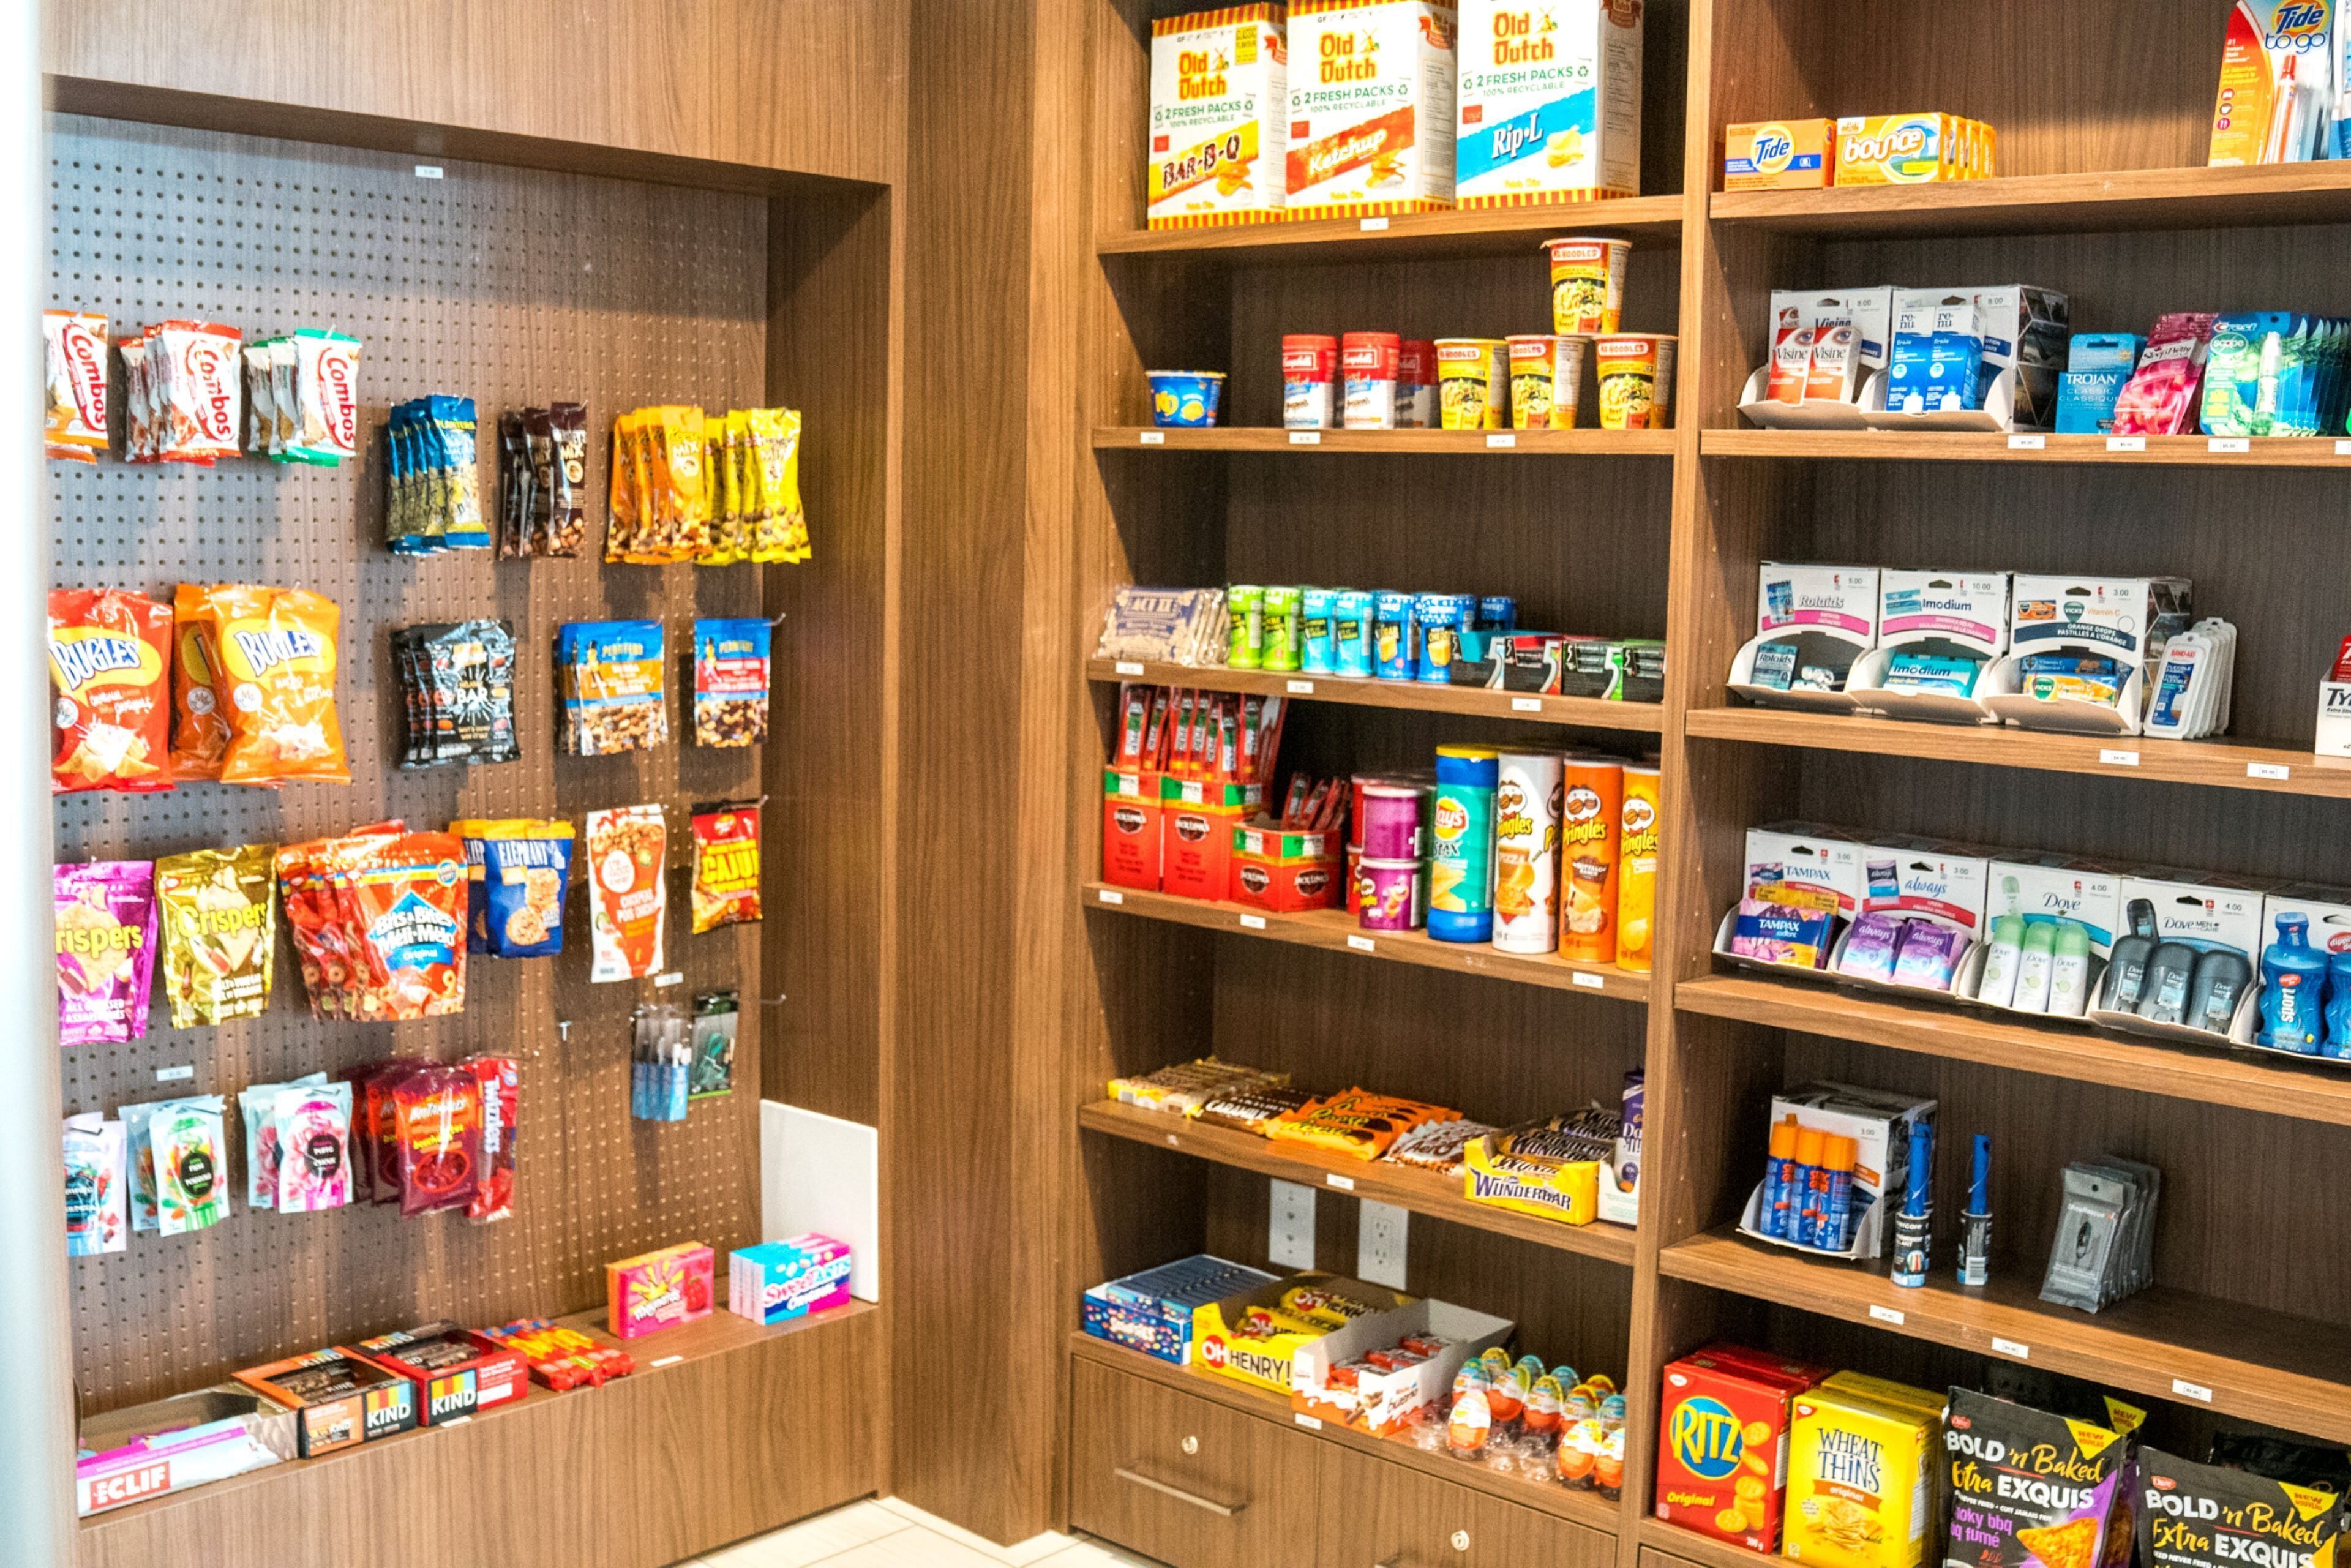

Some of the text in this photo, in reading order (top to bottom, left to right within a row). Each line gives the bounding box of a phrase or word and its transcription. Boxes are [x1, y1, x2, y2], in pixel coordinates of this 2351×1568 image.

[1493, 12, 1529, 38] Old
[2276, 5, 2325, 34] Tide
[1321, 33, 1354, 58] Old
[1493, 38, 1555, 66] Dutch
[2265, 32, 2327, 54] to go
[1179, 51, 1207, 75] Old
[1321, 58, 1376, 84] Dutch
[1477, 66, 1574, 87] 2 FRESH PACKS
[1179, 75, 1226, 100] Dutch
[1304, 85, 1395, 104] 2 FRESH PACKS
[1483, 81, 1565, 97] 100% RECYCLABLE
[1164, 100, 1242, 119] 2 FRESH PACKS
[1310, 99, 1387, 113] 100% RECYCLABLE
[1169, 114, 1235, 128] 100% RECYCLABLE
[1307, 128, 1389, 178] Ketchup
[1755, 137, 1791, 164] Tide
[1843, 129, 1924, 164] bounce
[1162, 133, 1242, 190] BAR-B-Q
[1777, 347, 1807, 360] Visine
[1814, 347, 1847, 359] Visine
[2213, 340, 2244, 351] scope
[70, 335, 107, 424] Combos
[2066, 374, 2118, 385] TROJAN
[193, 350, 231, 435] Combos
[324, 356, 357, 443] Combos
[1798, 595, 1845, 609] Rolaids
[1922, 598, 1972, 612] Imodium
[2087, 607, 2114, 617] Vitamin
[2068, 623, 2117, 637] ORANGE DROPS
[2096, 633, 2127, 647] L'ORANGE
[49, 637, 141, 691] BUGLES
[234, 630, 318, 677] BUGLES
[1485, 637, 1505, 689] 5
[1758, 653, 1793, 664] Rolaids
[1539, 640, 1560, 694] 5
[1601, 647, 1622, 700] 5
[1893, 664, 1951, 677] Imodium
[456, 688, 489, 705] BAR
[497, 841, 549, 866] ELEPHANT
[1785, 866, 1831, 880] TAMPAX
[1905, 876, 1948, 898] always
[2043, 892, 2081, 910] Dove
[176, 902, 268, 939] Crispers
[1758, 919, 1801, 932] TAMPAX
[2164, 917, 2195, 930] Dove
[55, 923, 143, 959] rispers
[1858, 923, 1891, 940] always
[1912, 931, 1944, 947] always
[402, 949, 438, 961] Original
[1991, 946, 2010, 956] Dove
[2027, 953, 2048, 964] Dove
[2057, 958, 2077, 967] Dove
[2281, 988, 2297, 1024] sport
[1204, 1099, 1270, 1120] CARAMILK
[1310, 1106, 1370, 1127] Reese
[1281, 1119, 1352, 1136] Reese
[1404, 1138, 1452, 1156] Aero
[1469, 1167, 1572, 1212] WUNDERBAR
[369, 1334, 415, 1352] KIND
[299, 1351, 345, 1367] KIND
[1202, 1341, 1292, 1387] OH HENRY!
[431, 1388, 476, 1416] KIND
[367, 1402, 411, 1429] KIND
[2113, 1408, 2137, 1420] NEW
[1673, 1403, 1742, 1464] RITZ
[1817, 1427, 1883, 1460] WHEAT
[1946, 1430, 2104, 1483] BOLD 'n Baked
[107, 1465, 166, 1500] CLIF
[1997, 1474, 2096, 1510] EXQUIS
[2154, 1476, 2173, 1487] Dare
[1666, 1491, 1715, 1508] Original
[1829, 1485, 1865, 1502] original
[2293, 1492, 2323, 1504] NEW
[1987, 1513, 2014, 1536] bbq
[2145, 1489, 2327, 1547] BOLD 'n Baked
[1965, 1523, 2001, 1548] fumé
[2153, 1518, 2315, 1568] Extra EXQUIS
